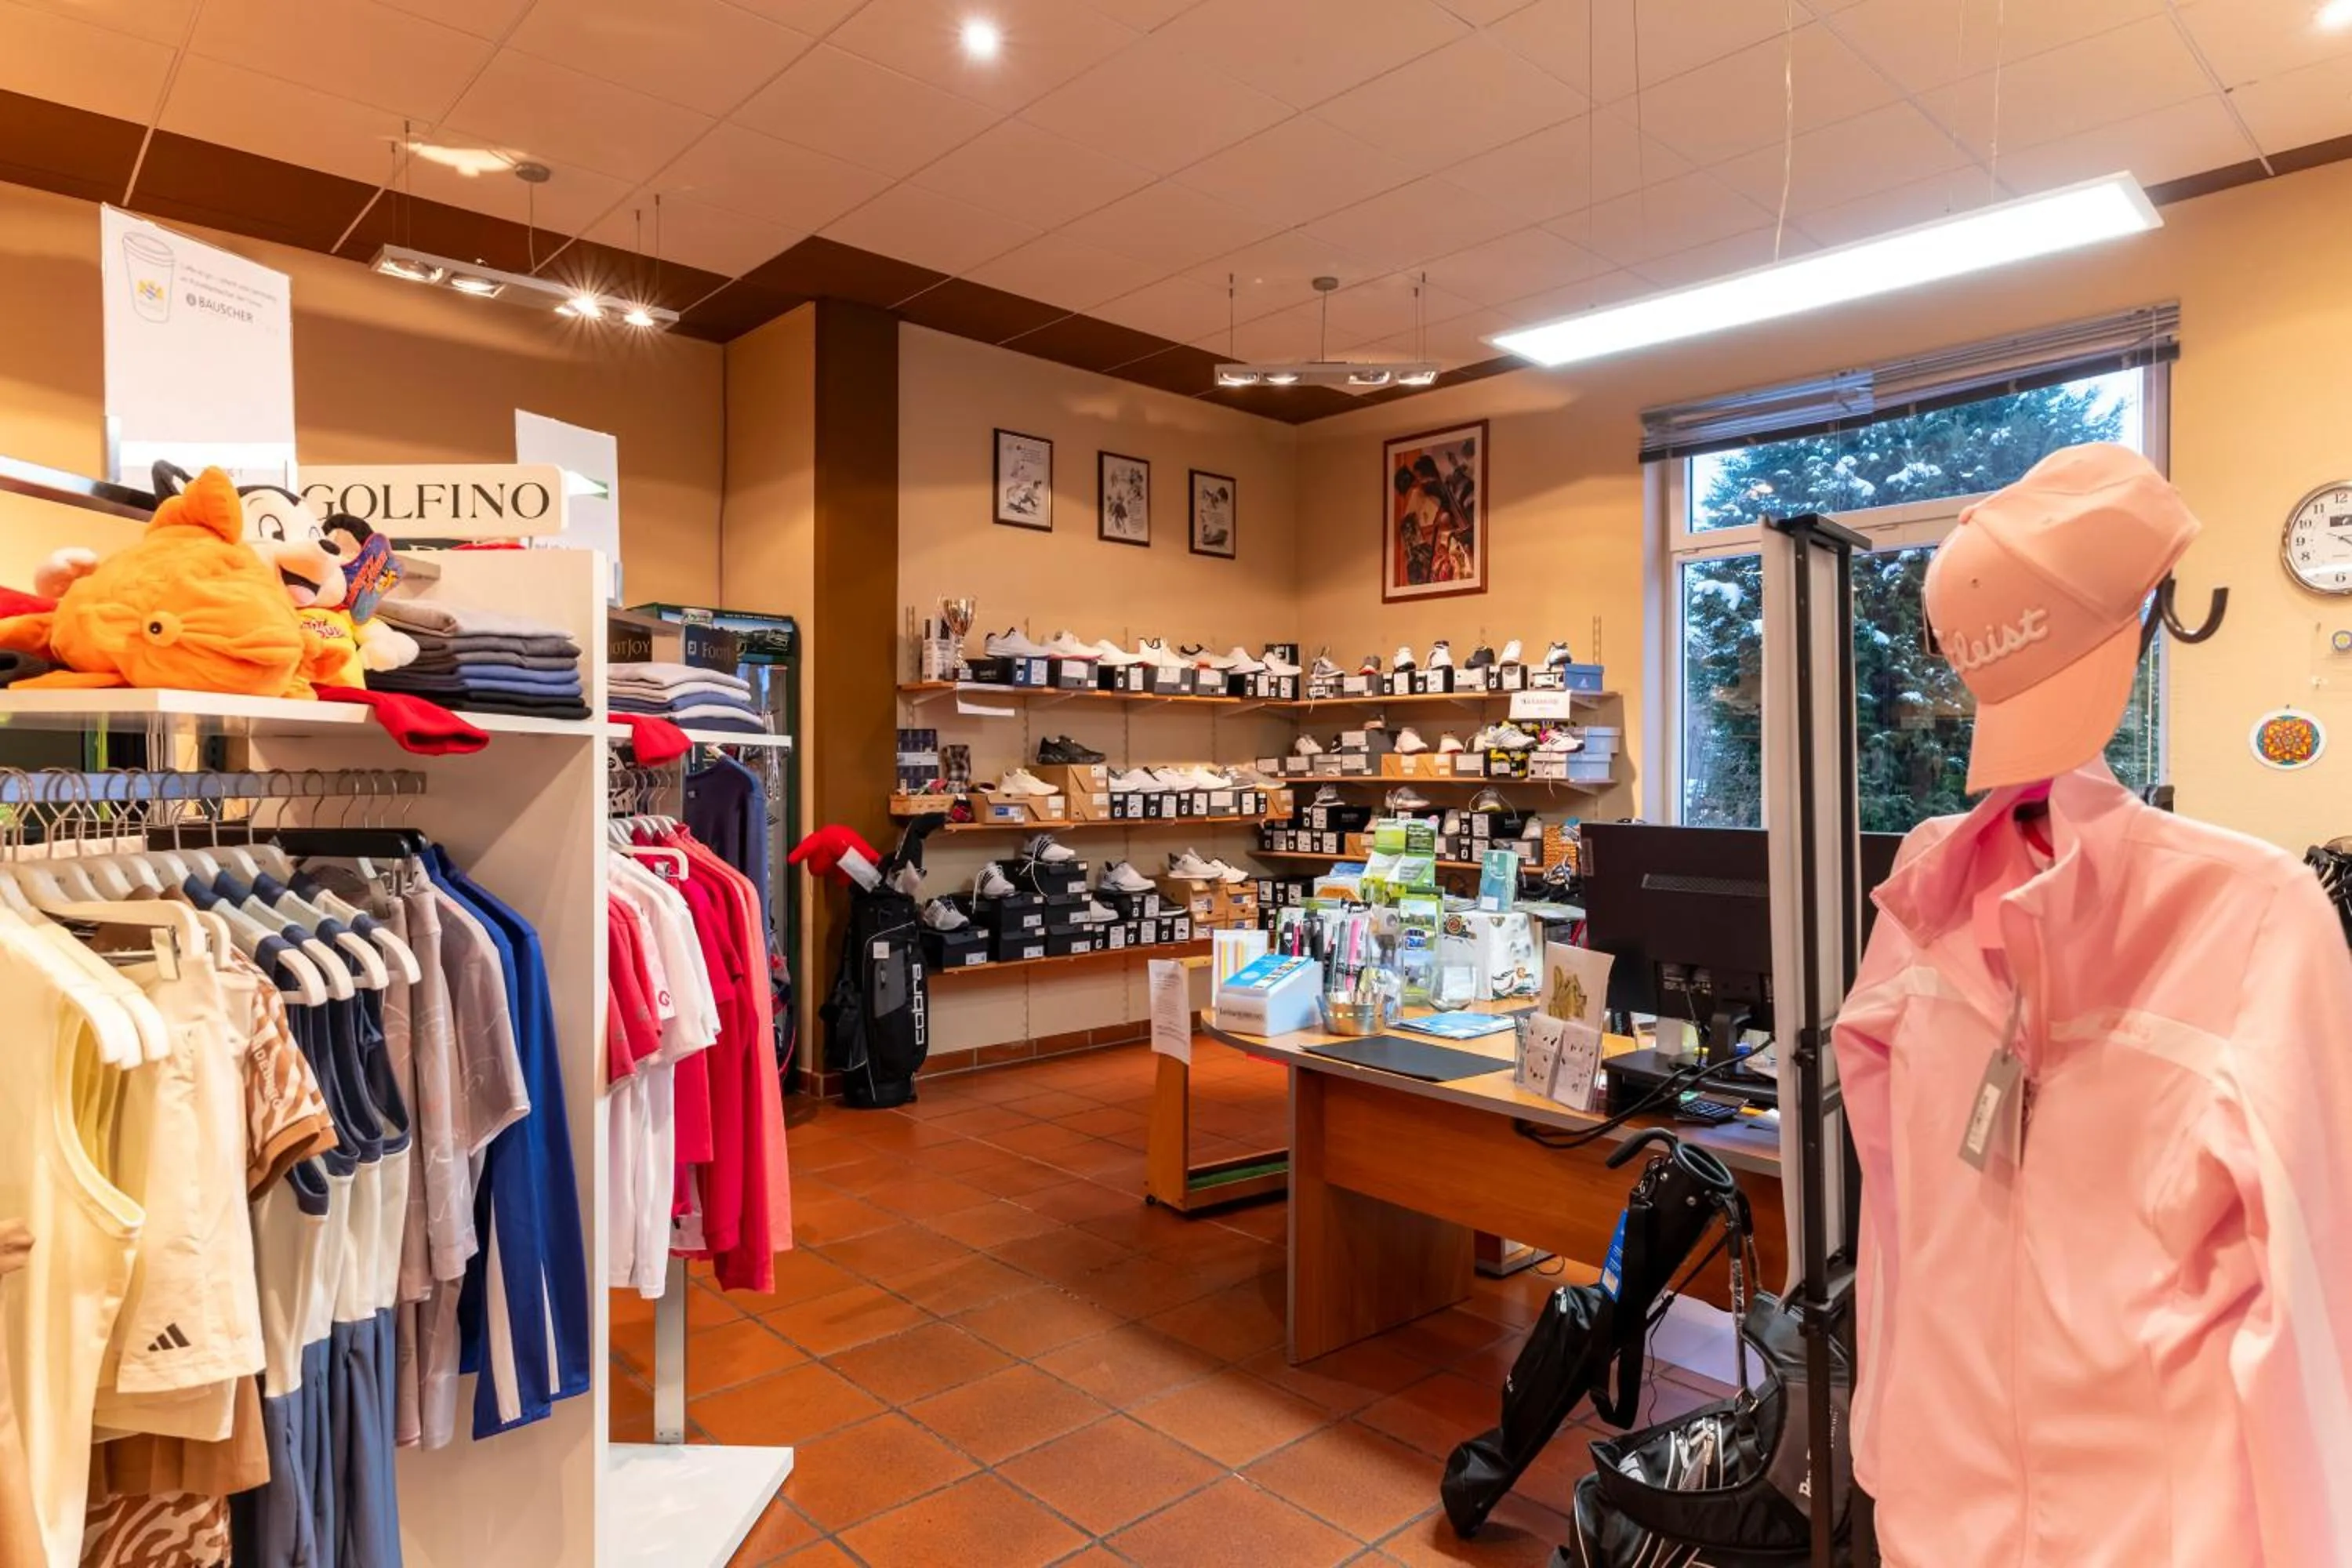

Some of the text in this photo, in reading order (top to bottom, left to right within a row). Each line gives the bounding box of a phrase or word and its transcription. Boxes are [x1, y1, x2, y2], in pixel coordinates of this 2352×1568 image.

[198, 296, 254, 324] BAUSCHER
[301, 482, 550, 520] GOLFINO
[2335, 493, 2348, 504] 12
[2314, 503, 2325, 514] 11
[2299, 519, 2312, 529] 10
[2296, 536, 2305, 547] 9
[2301, 551, 2310, 561] 8
[2335, 572, 2347, 583] 6
[911, 964, 925, 1045] cobra
